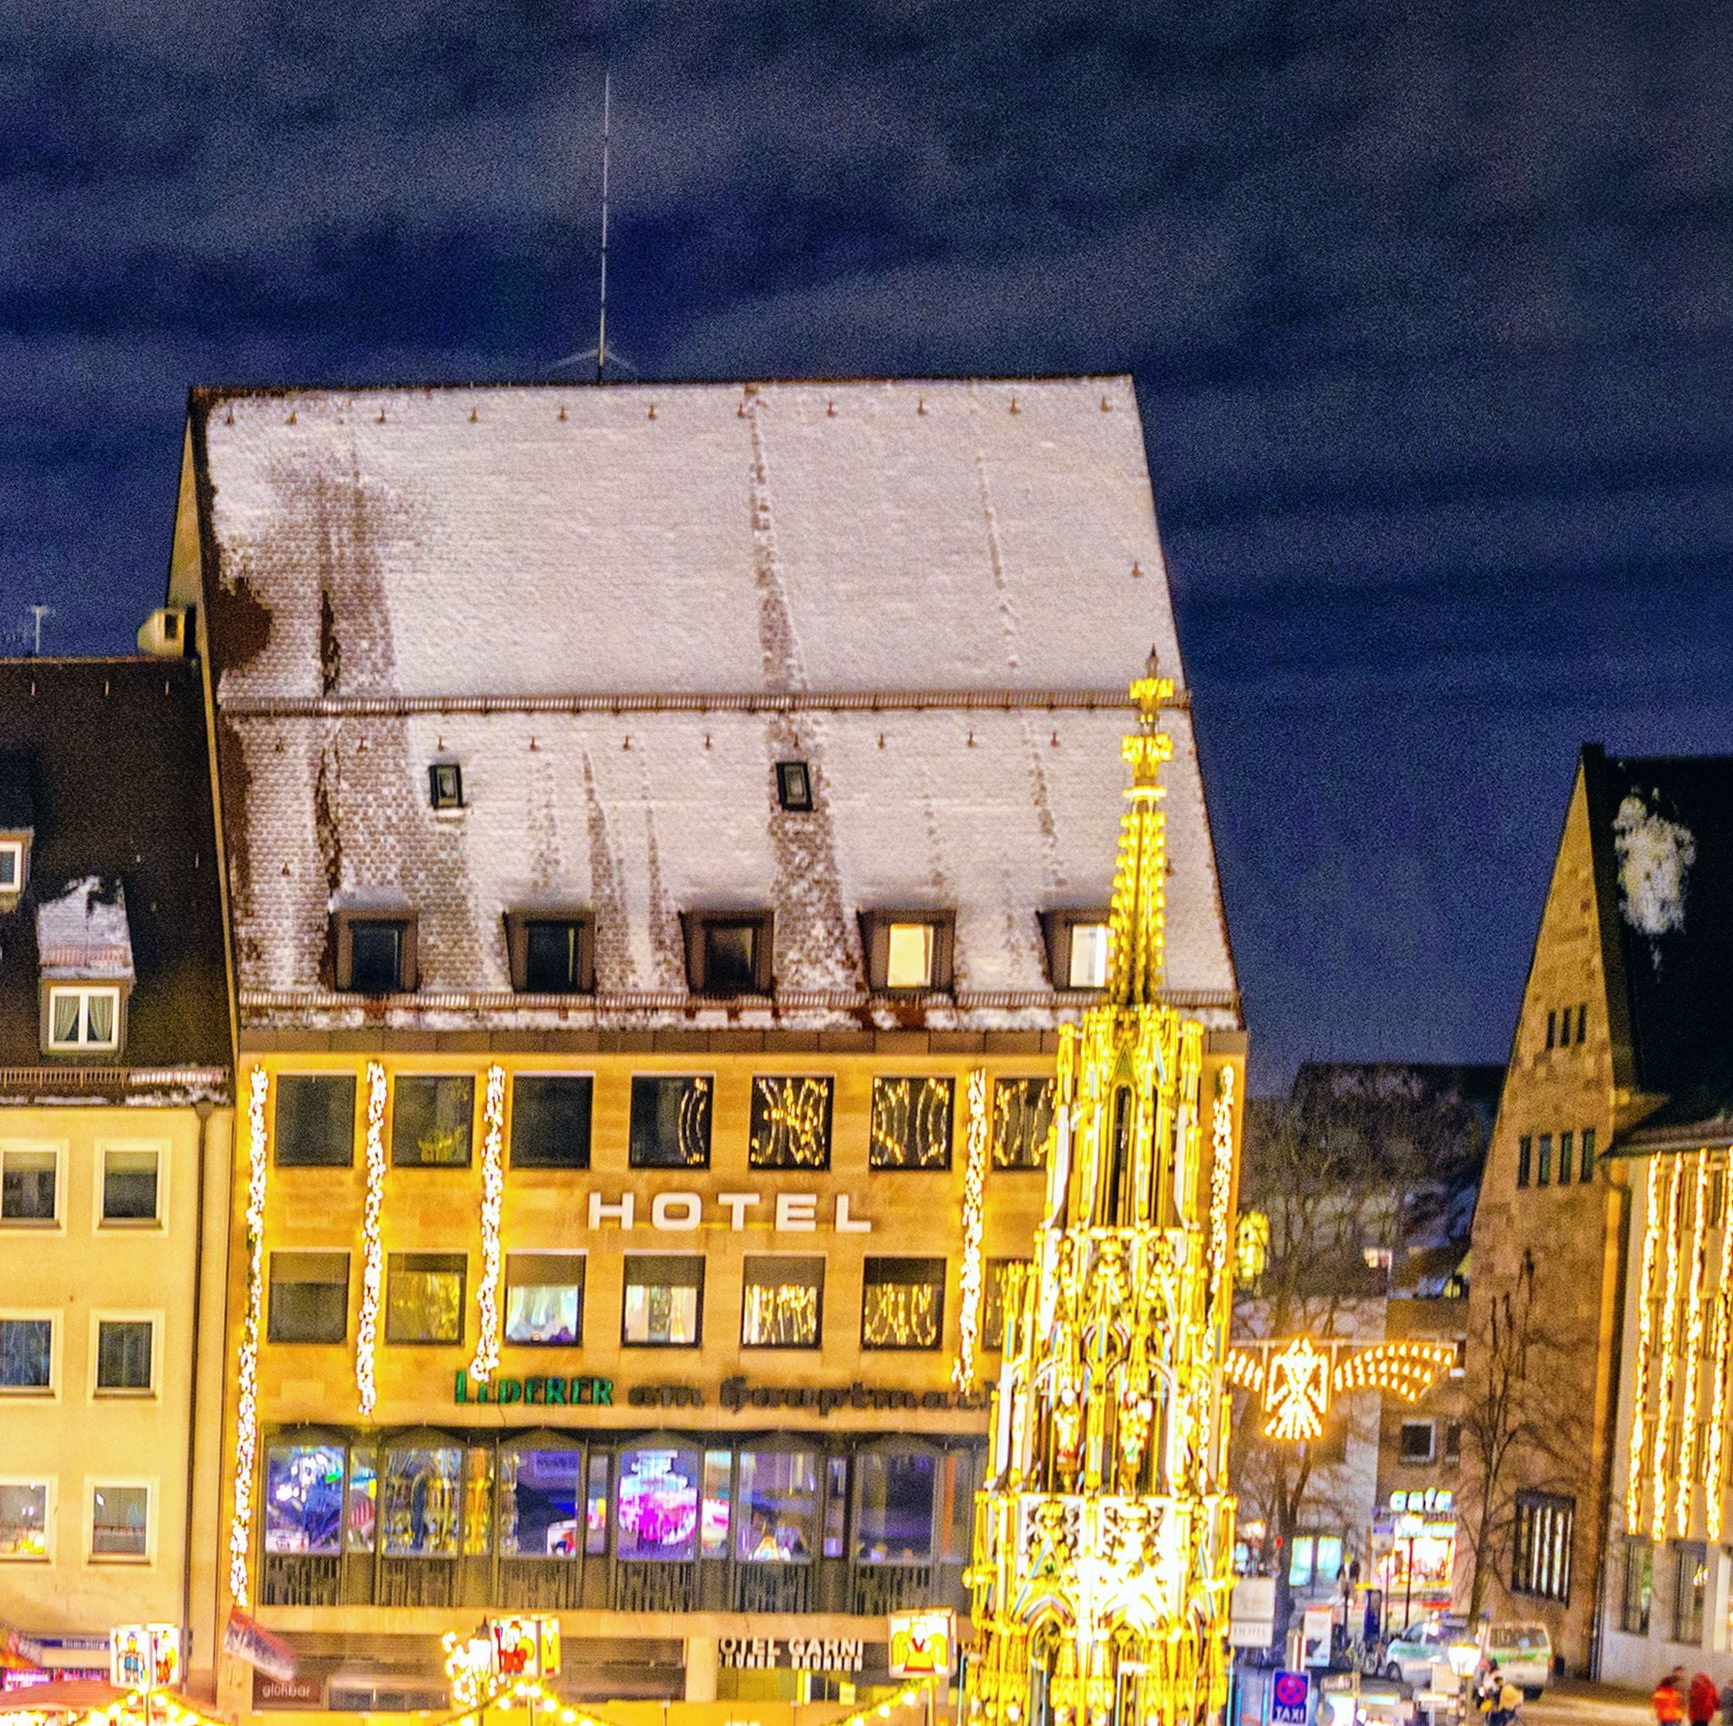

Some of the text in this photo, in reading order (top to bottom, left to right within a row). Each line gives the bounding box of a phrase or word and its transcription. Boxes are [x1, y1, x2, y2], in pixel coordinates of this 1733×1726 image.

[588, 1191, 872, 1233] HOTEL
[787, 1636, 864, 1657] GARNI
[1274, 1706, 1305, 1724] TAXI
